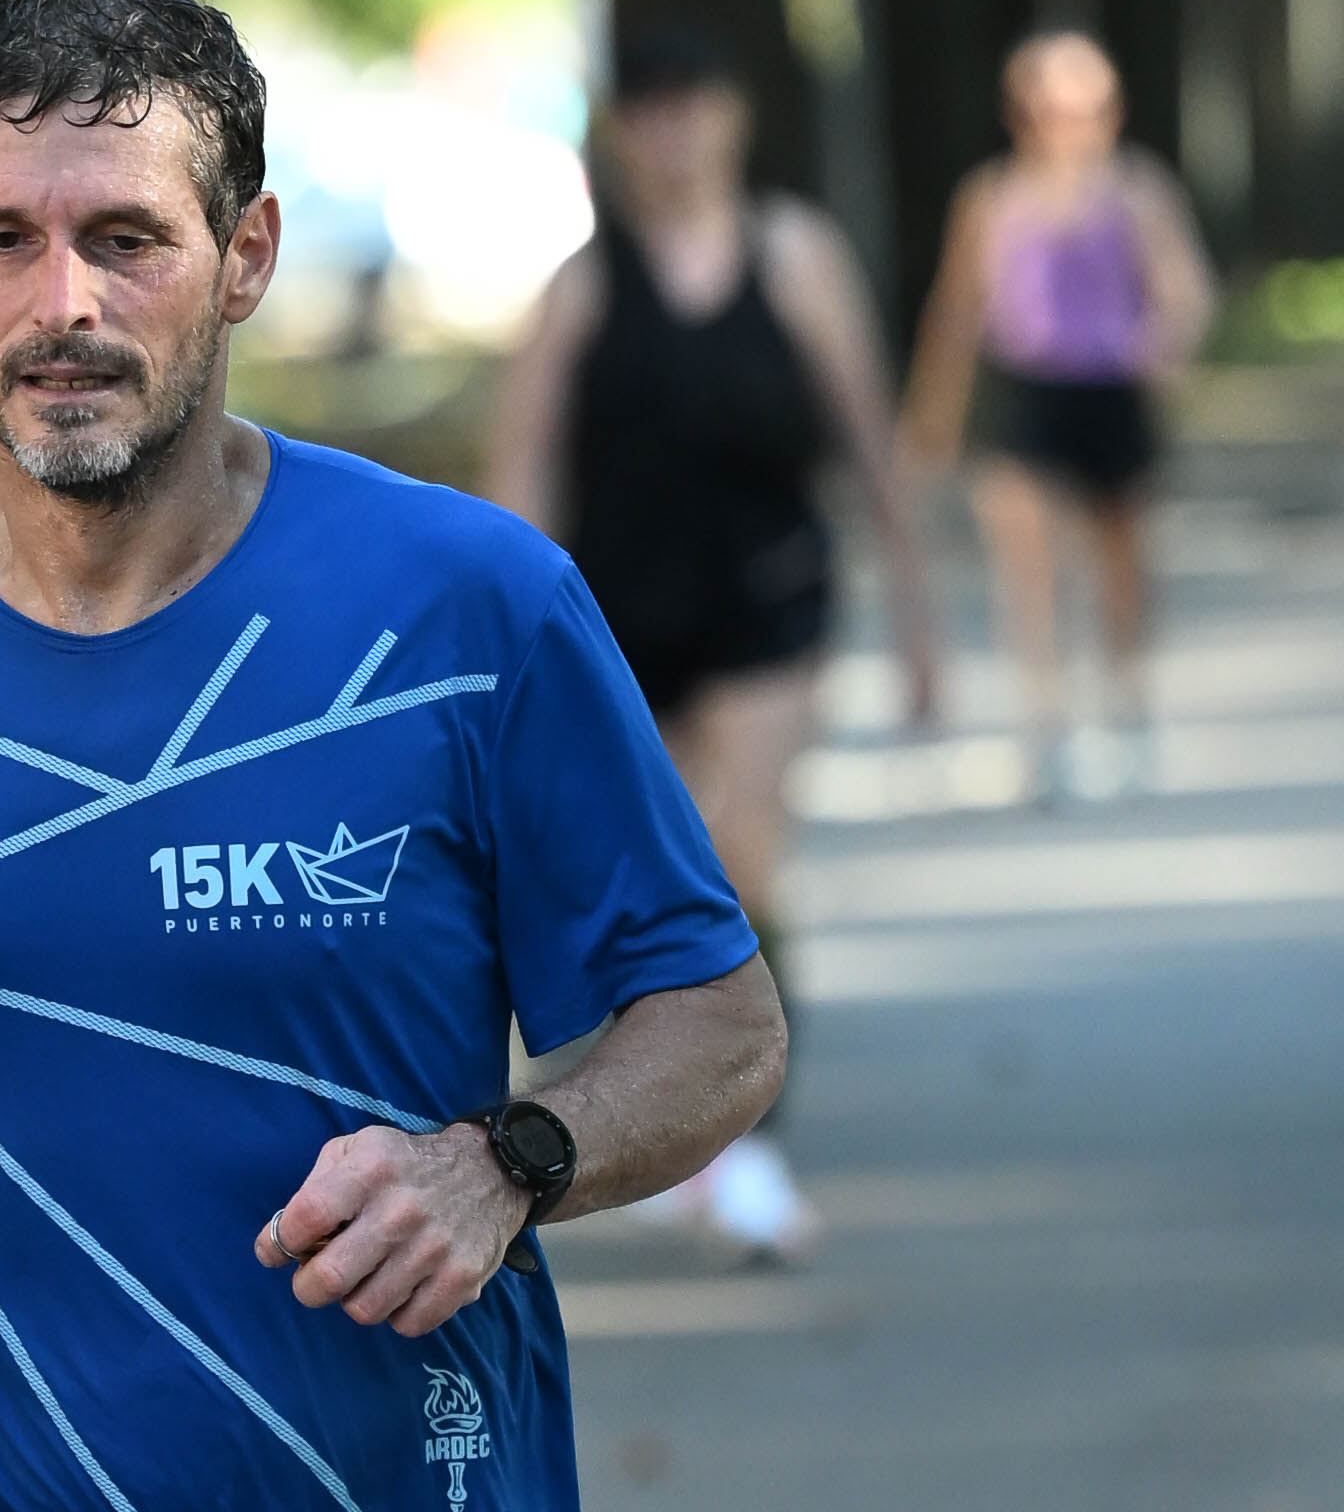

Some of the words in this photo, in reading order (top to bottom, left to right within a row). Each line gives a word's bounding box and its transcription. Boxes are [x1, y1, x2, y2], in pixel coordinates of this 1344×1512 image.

[149, 841, 285, 911] 15K
[164, 913, 286, 935] PUERTO
[299, 911, 388, 928] NORTE
[425, 1433, 491, 1465] ARDEC
